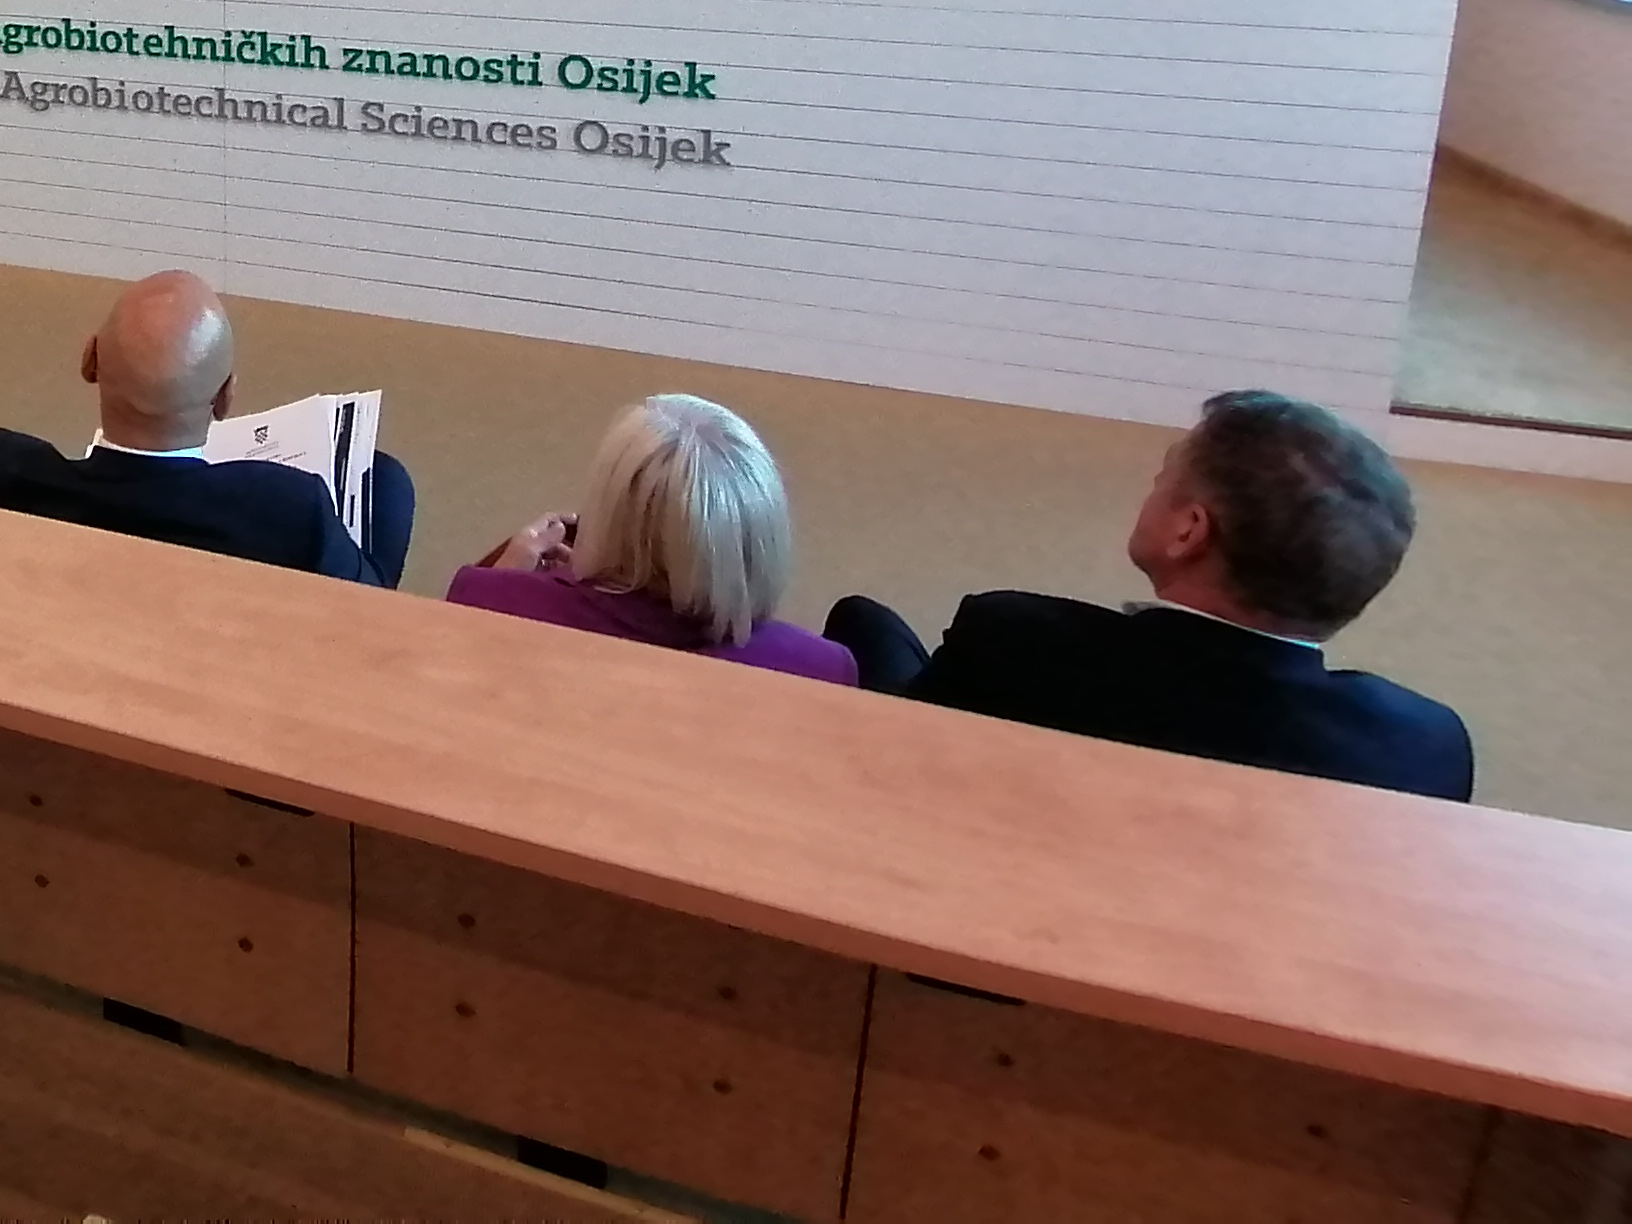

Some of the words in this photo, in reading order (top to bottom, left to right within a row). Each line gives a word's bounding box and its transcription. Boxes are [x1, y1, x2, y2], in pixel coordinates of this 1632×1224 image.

[341, 51, 544, 89] znanosti
[558, 54, 716, 105] Osijek
[359, 101, 559, 151] Sciences
[572, 120, 733, 172] Osijek
